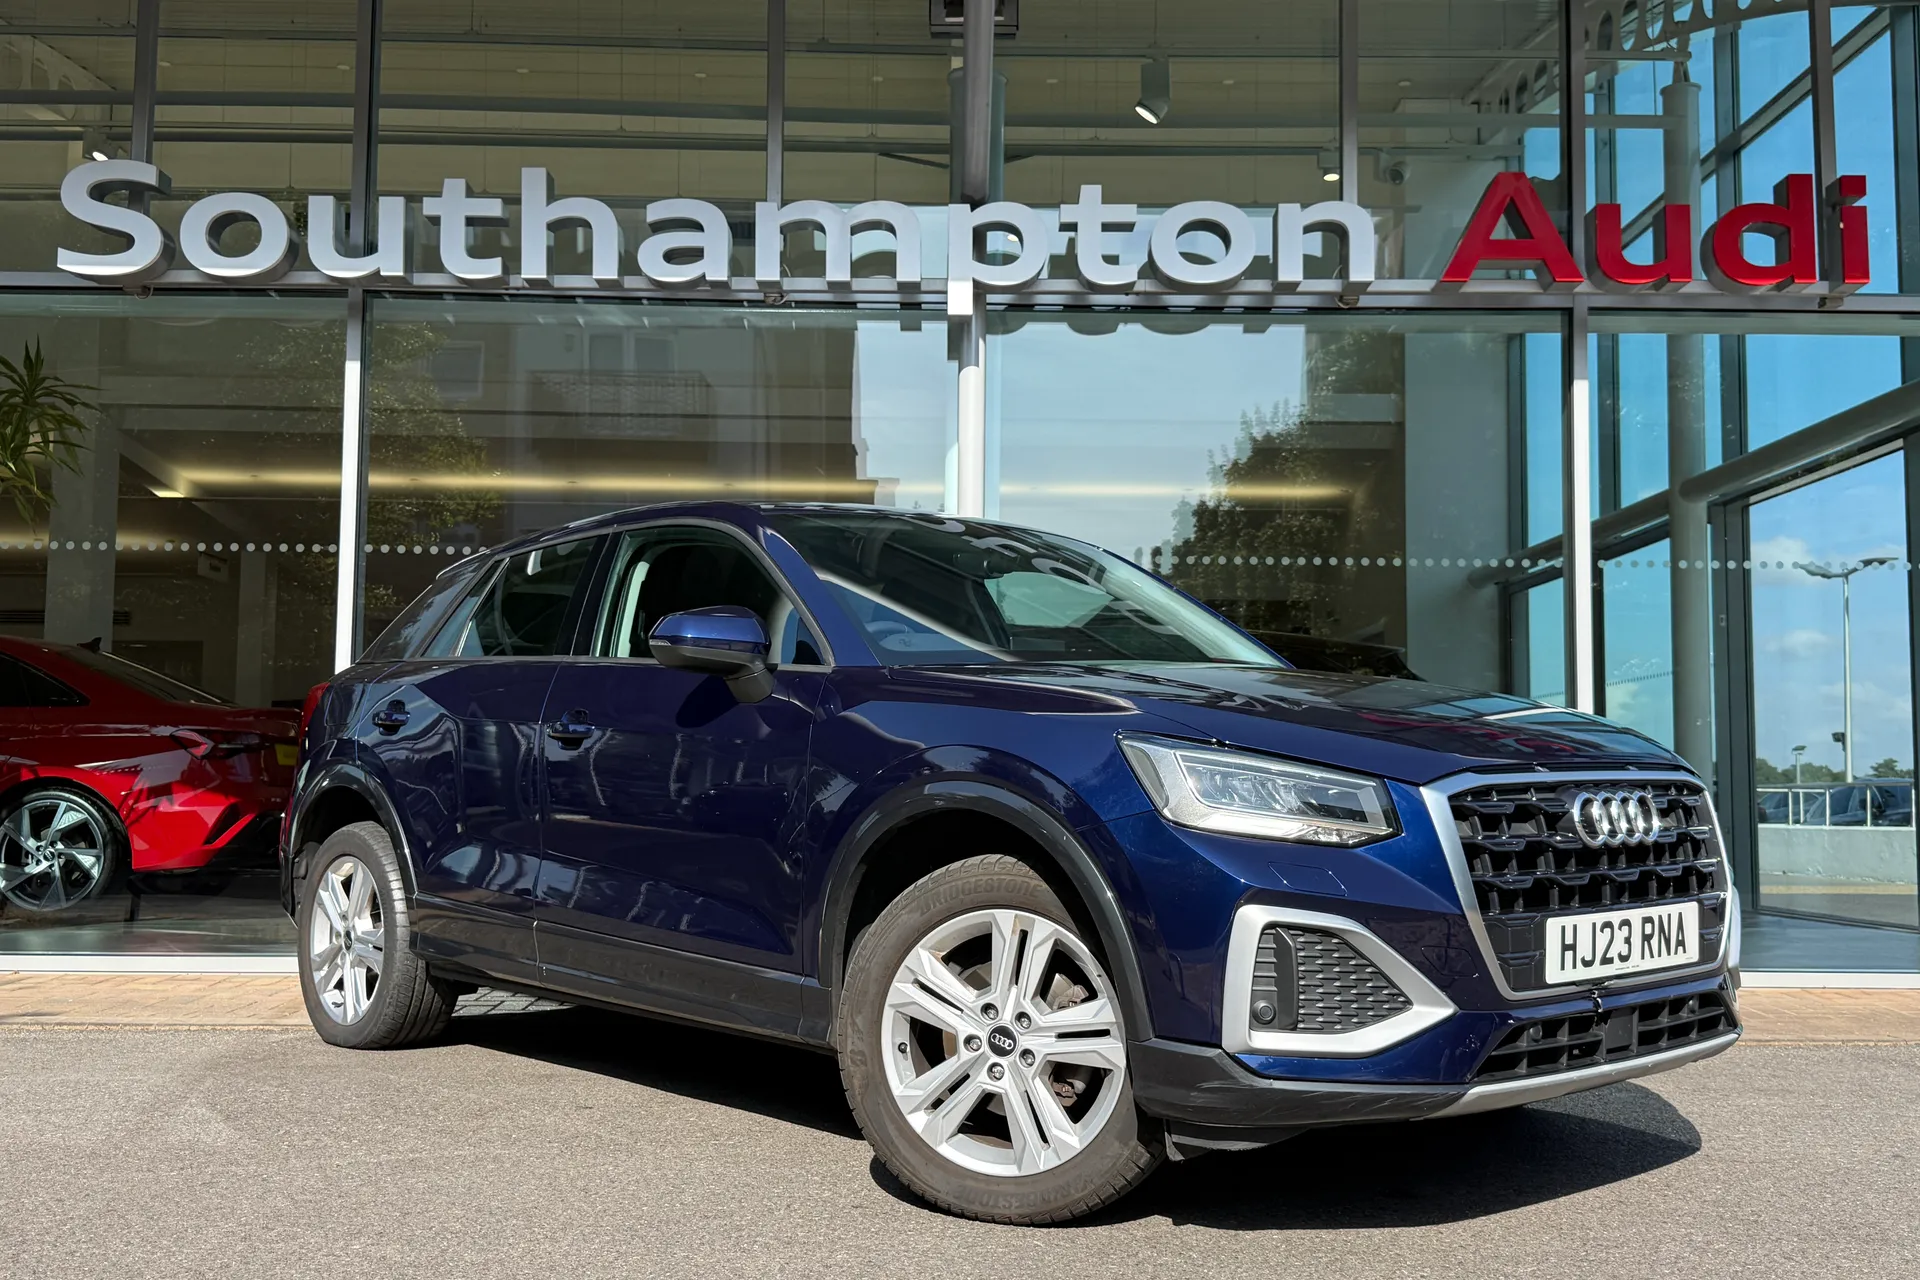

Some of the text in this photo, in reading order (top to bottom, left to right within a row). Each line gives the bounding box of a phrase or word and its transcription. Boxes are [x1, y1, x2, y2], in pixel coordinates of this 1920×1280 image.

[57, 159, 1870, 316] Southampton Audi
[1560, 912, 1686, 971] HJ23 RNA
